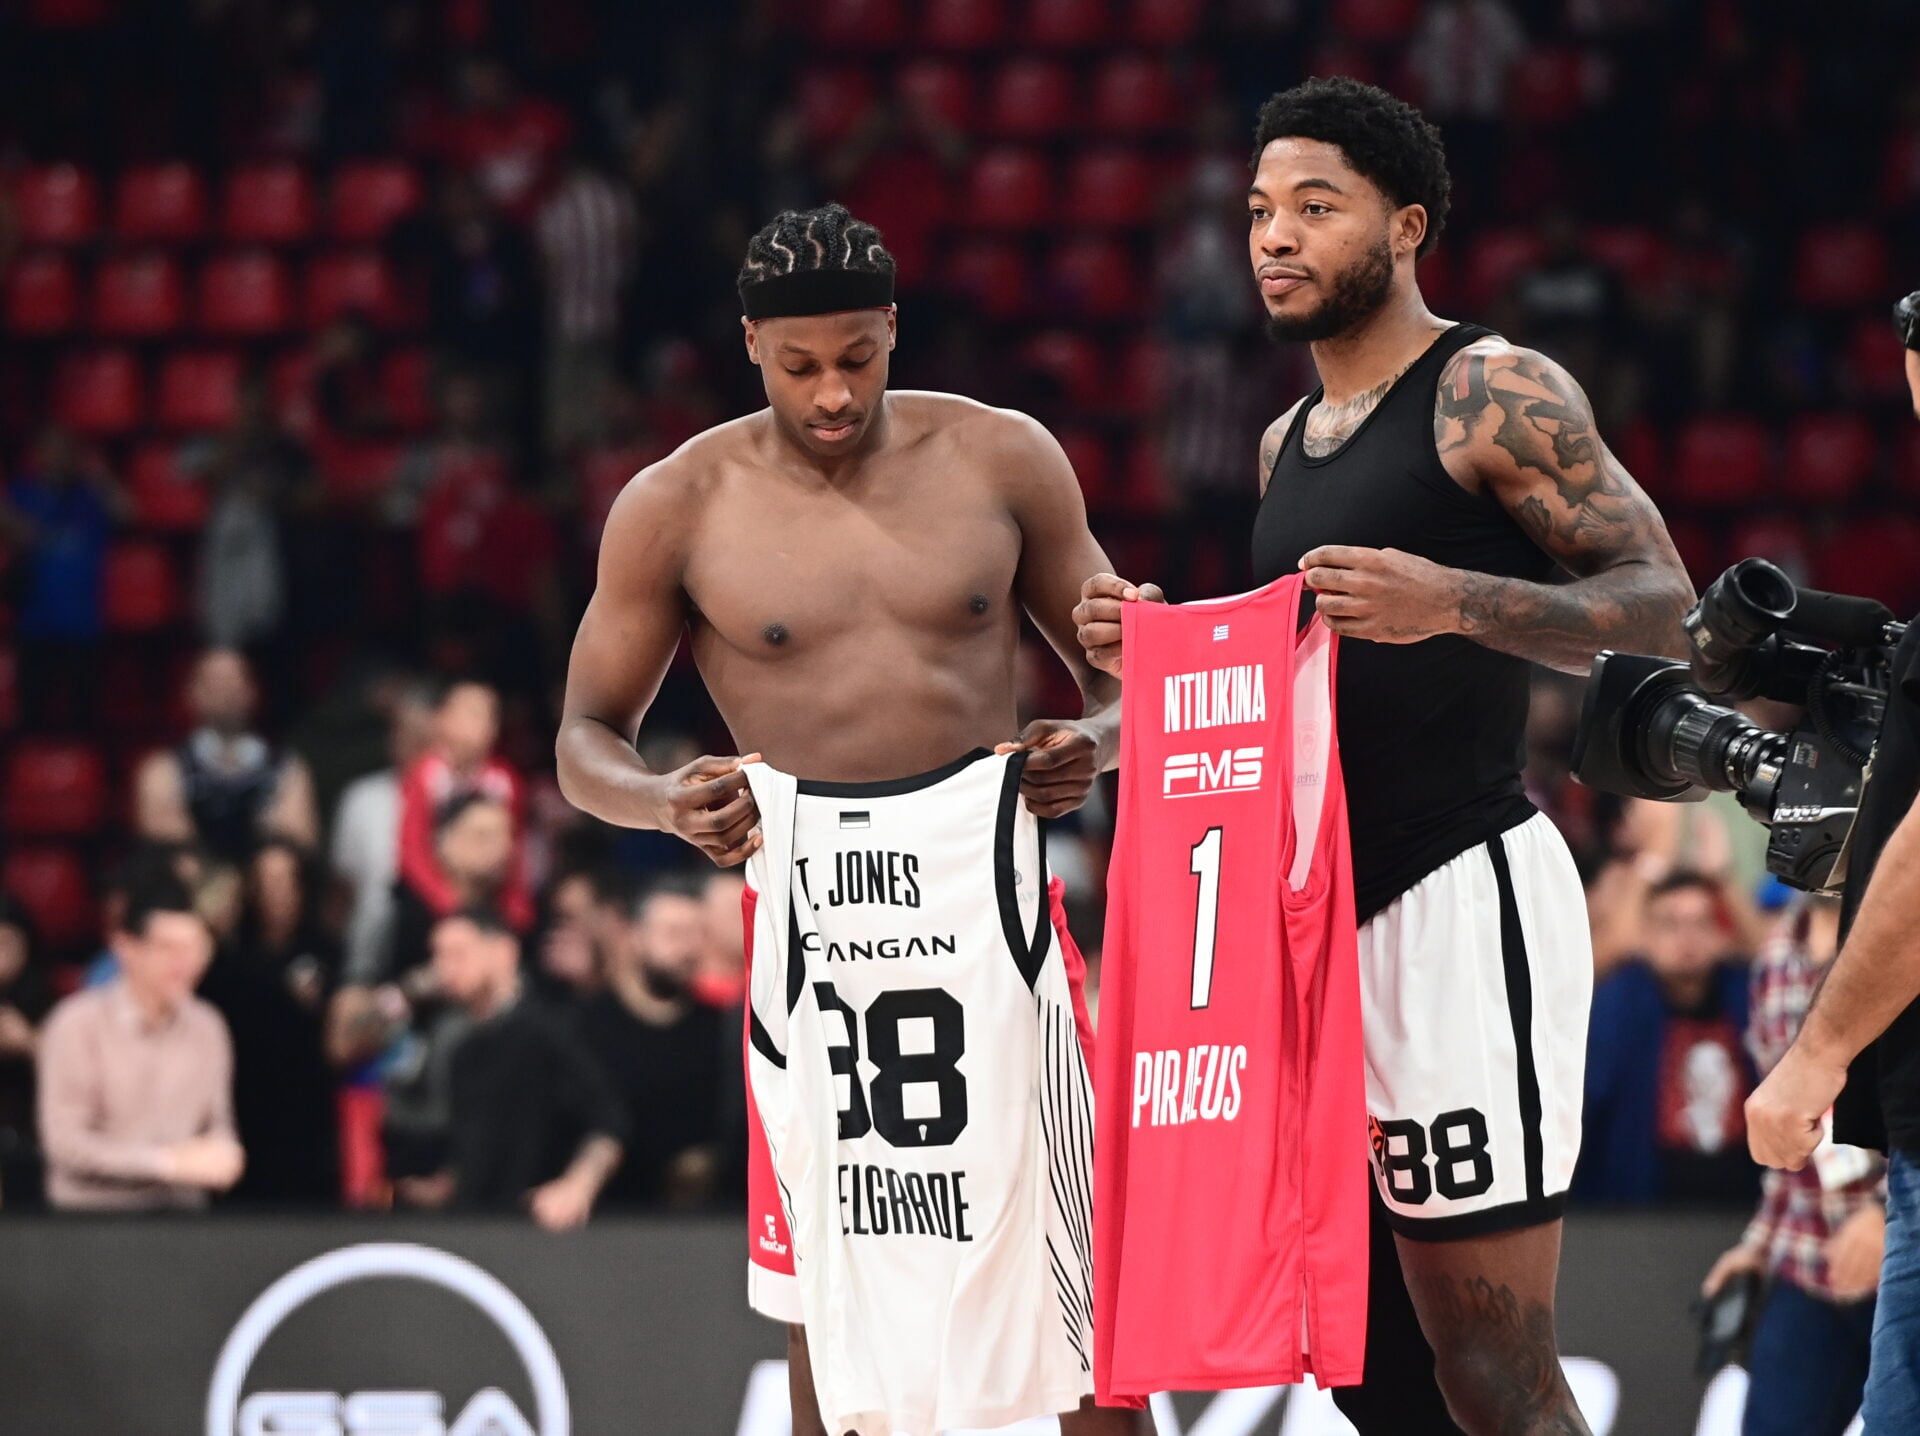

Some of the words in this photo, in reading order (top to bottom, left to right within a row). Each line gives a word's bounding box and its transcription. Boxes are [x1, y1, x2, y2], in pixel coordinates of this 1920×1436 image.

[1163, 664, 1266, 733] NTILIKINA
[1163, 746, 1264, 794] FMS
[828, 850, 921, 909] JONES
[801, 932, 956, 963] CANGAN
[1189, 825, 1223, 1011] 1
[1132, 1044, 1247, 1128] PIRAEUS
[1383, 1107, 1495, 1205] 88
[838, 1163, 974, 1243] ELGRADE
